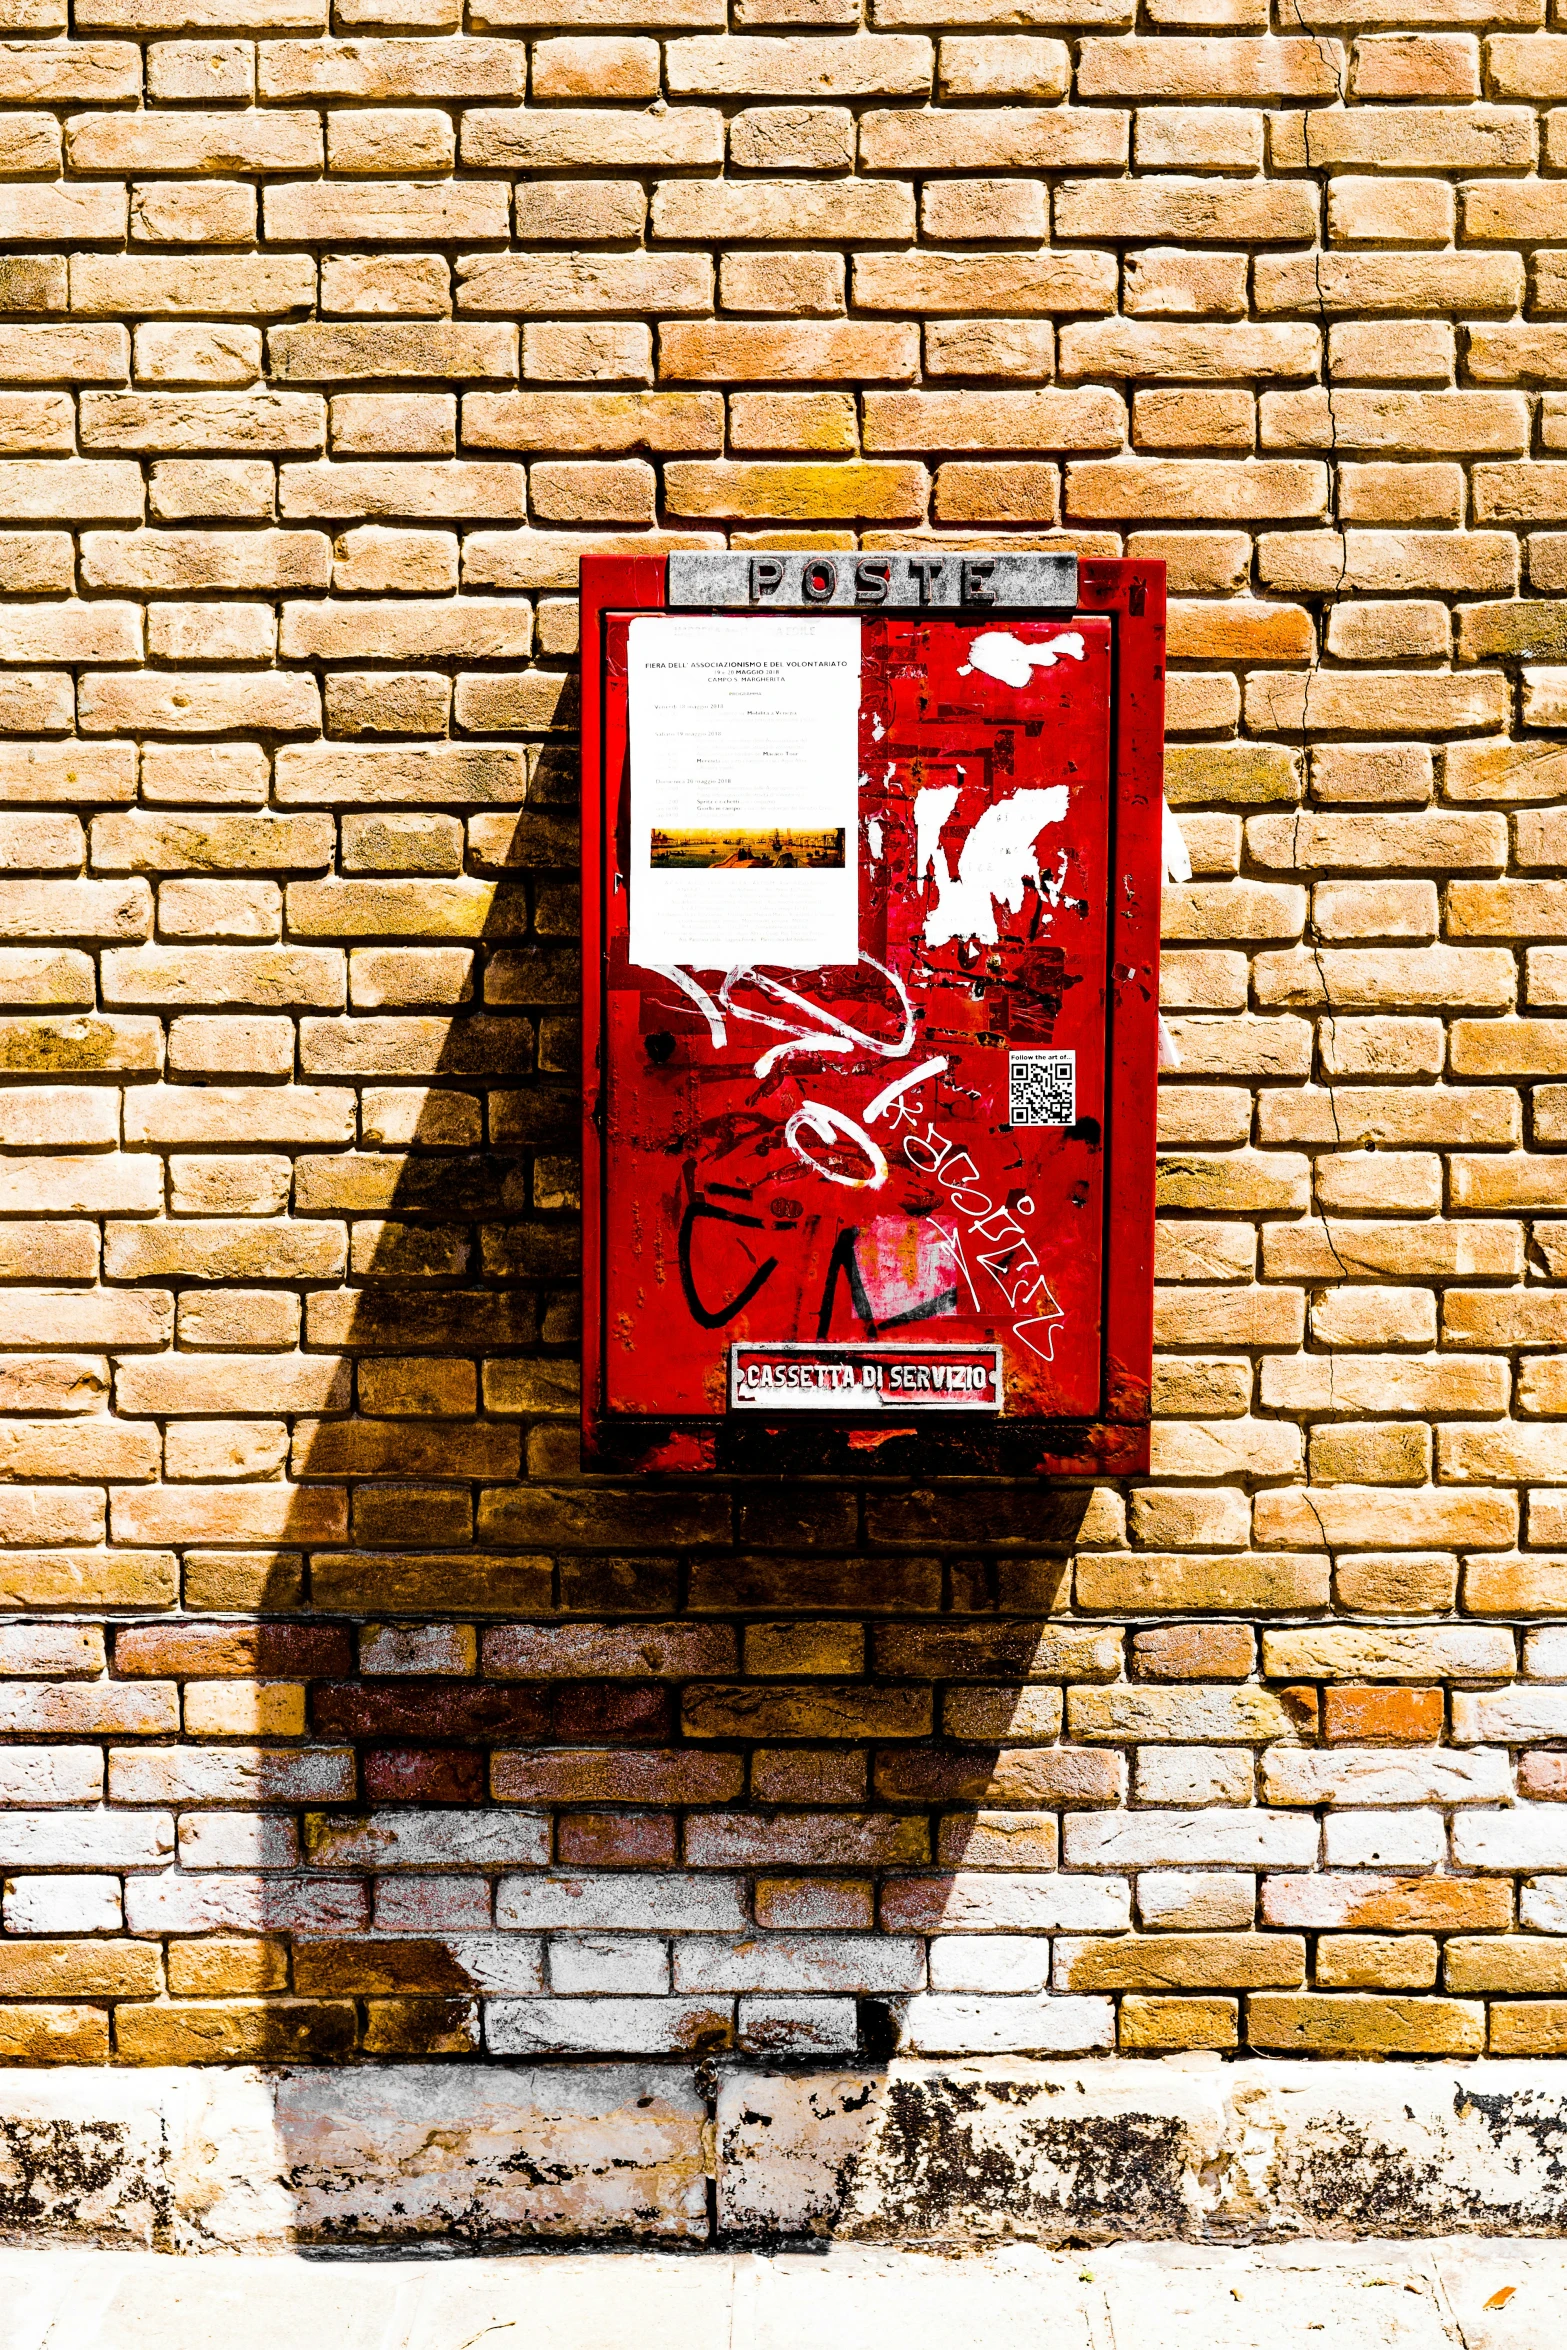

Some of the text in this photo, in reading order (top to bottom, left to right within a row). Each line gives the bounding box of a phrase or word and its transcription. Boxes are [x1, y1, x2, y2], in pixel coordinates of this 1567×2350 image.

[751, 557, 997, 601] POSTE
[786, 660, 848, 668] VOLONTARIATO
[746, 1363, 987, 1392] CASSETTA DI SERVIZIO
